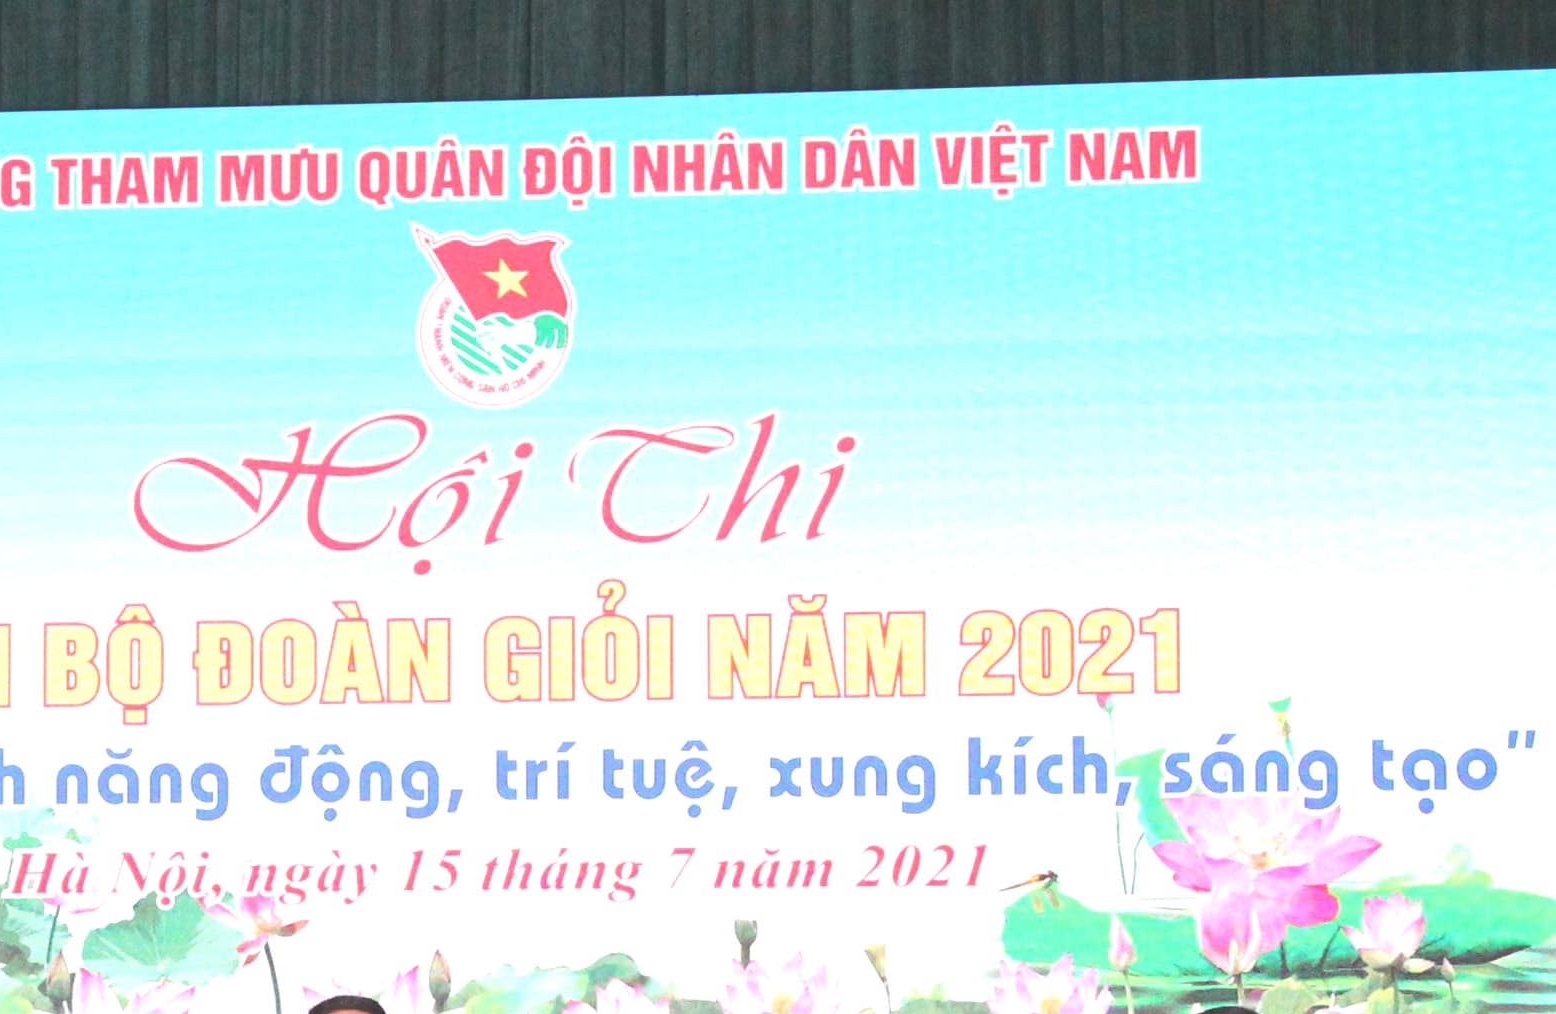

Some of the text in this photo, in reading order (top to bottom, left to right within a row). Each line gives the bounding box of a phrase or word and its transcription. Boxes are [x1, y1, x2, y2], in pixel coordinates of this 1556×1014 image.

[52, 156, 197, 205] THAM
[221, 149, 337, 201] MƯU
[360, 140, 503, 204] QUÂN
[524, 137, 611, 205] ĐỘI
[634, 133, 782, 192] NHÂN
[806, 129, 914, 188] DÂN
[936, 125, 1048, 195] VIỆT
[1070, 130, 1196, 180] NAM
[135, 415, 855, 574] Hội Thi
[44, 604, 164, 725] BỘ
[192, 601, 451, 706] ĐOÀN
[484, 579, 674, 703] GIỎI
[707, 594, 926, 700] NĂM
[958, 608, 1181, 696] 2021
[57, 750, 228, 820] năng
[261, 745, 461, 820] động,
[497, 742, 573, 800] trí
[604, 741, 736, 817] tuệ,
[771, 755, 935, 813] xung
[969, 736, 1130, 804] kích,
[1165, 734, 1337, 809] sáng
[10, 845, 985, 906] Hà Nội, ngày 15 tháng 7 năm 2021
